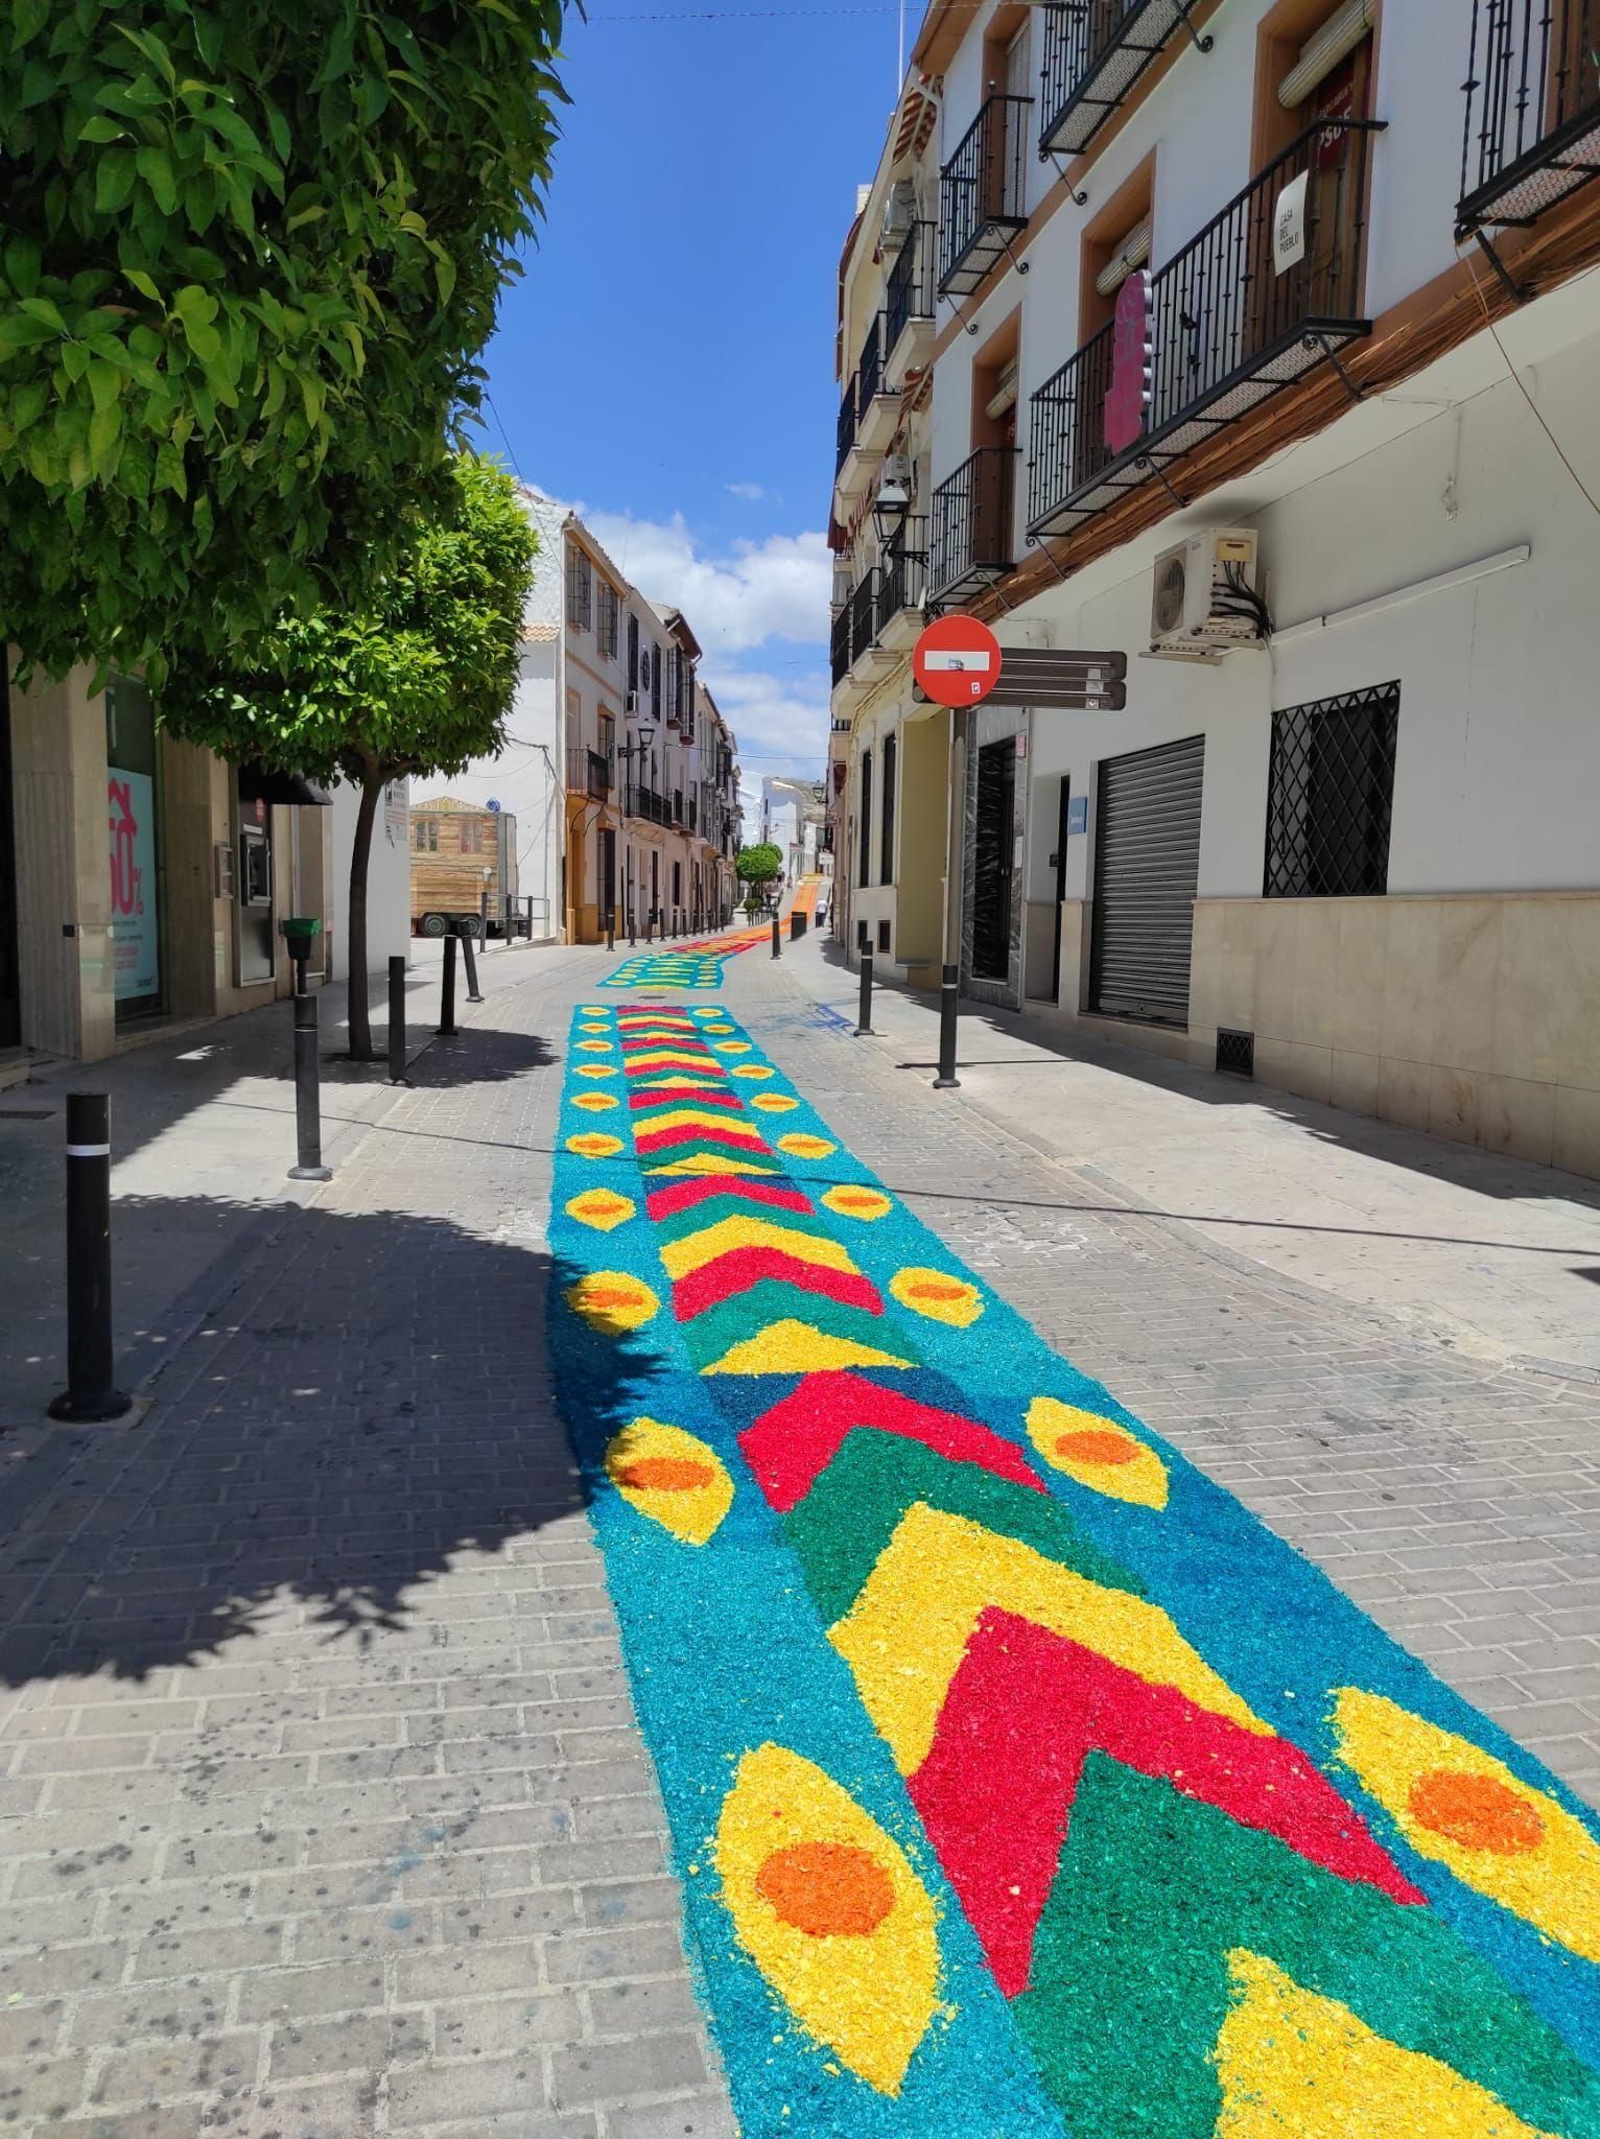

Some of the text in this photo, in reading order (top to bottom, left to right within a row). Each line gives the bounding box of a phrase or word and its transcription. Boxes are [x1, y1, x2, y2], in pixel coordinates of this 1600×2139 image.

[1280, 209, 1293, 226] CASA
[1280, 224, 1289, 241] DEL
[1280, 232, 1299, 254] PUEBLO
